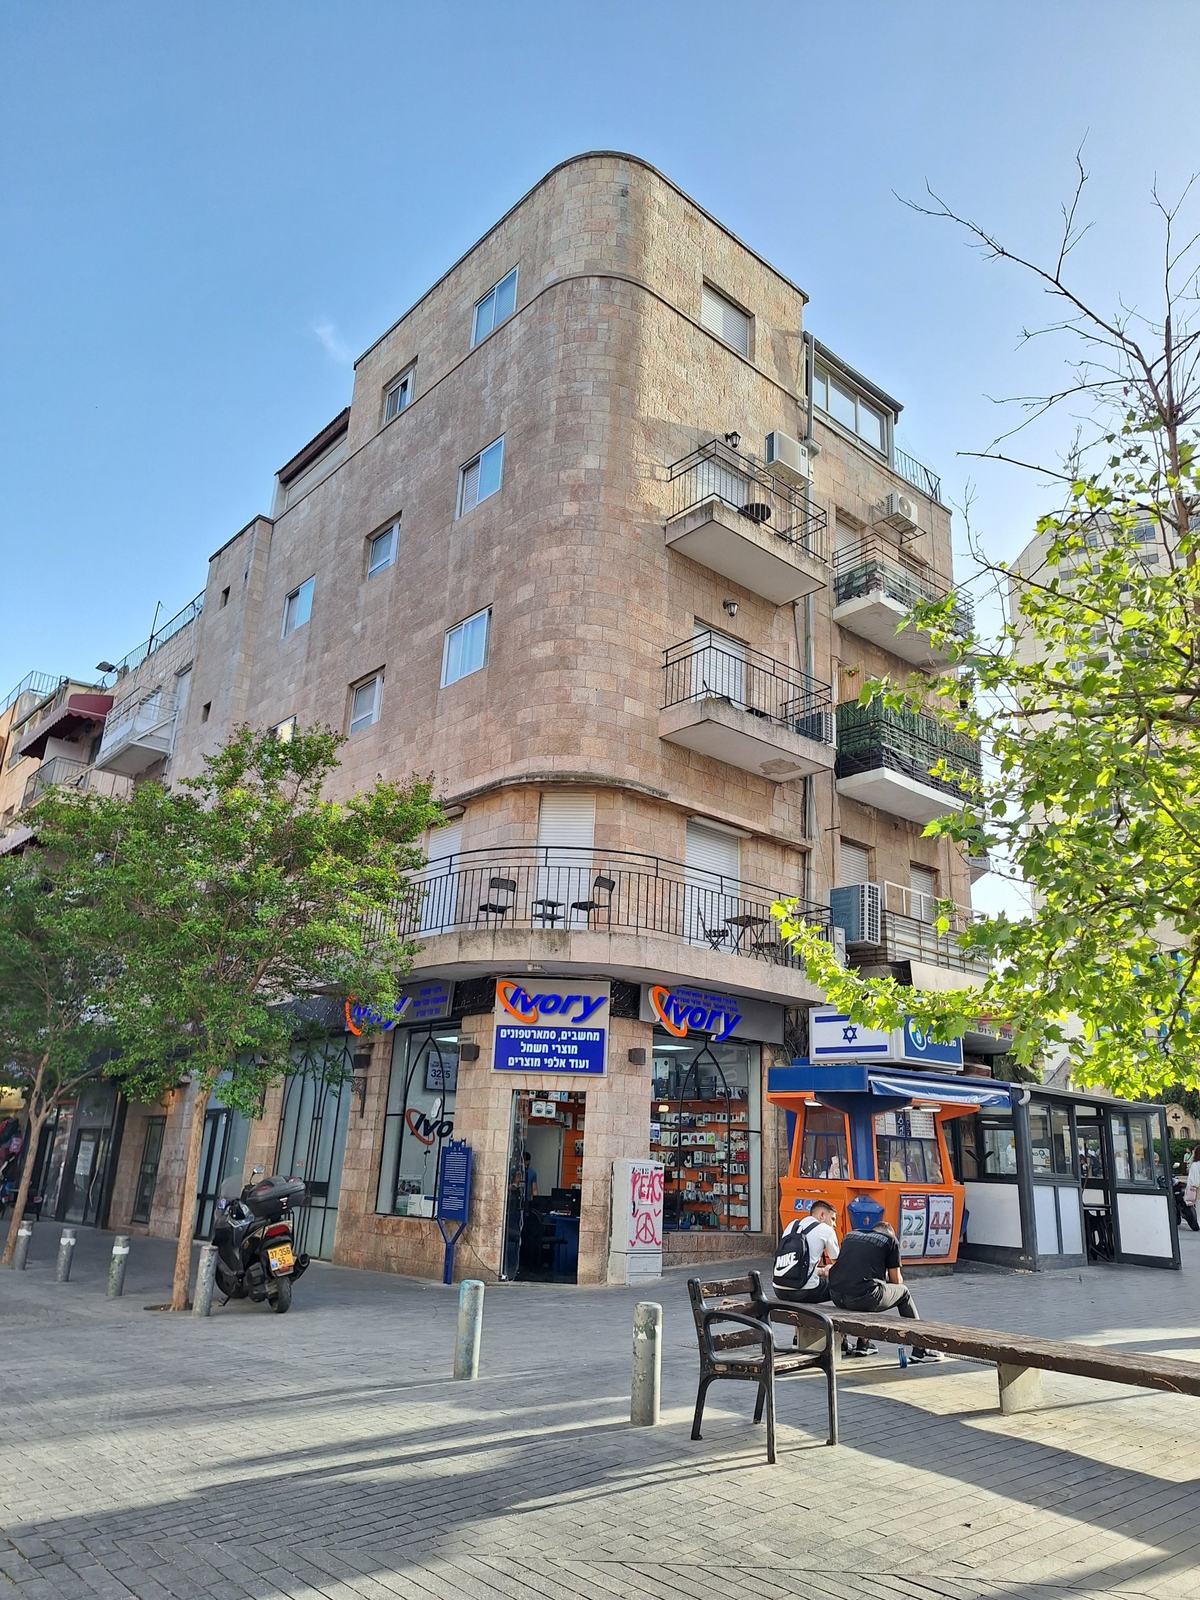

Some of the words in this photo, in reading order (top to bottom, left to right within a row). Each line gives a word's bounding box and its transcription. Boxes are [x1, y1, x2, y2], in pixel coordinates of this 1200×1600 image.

[504, 987, 608, 1024] Ivory
[660, 993, 743, 1043] Ivory
[500, 1028, 557, 1040] סמארטפונים
[520, 1041, 549, 1053] חשמל
[551, 1043, 578, 1055] מוצרי
[507, 1056, 541, 1067] מוצרים
[543, 1056, 566, 1068] אלפי
[569, 1058, 589, 1069] ועוד
[431, 1069, 450, 1078] 325
[410, 1113, 454, 1138] Ivo
[903, 1214, 925, 1236] 22
[930, 1211, 951, 1235] 44
[776, 1252, 797, 1267] NIKE
